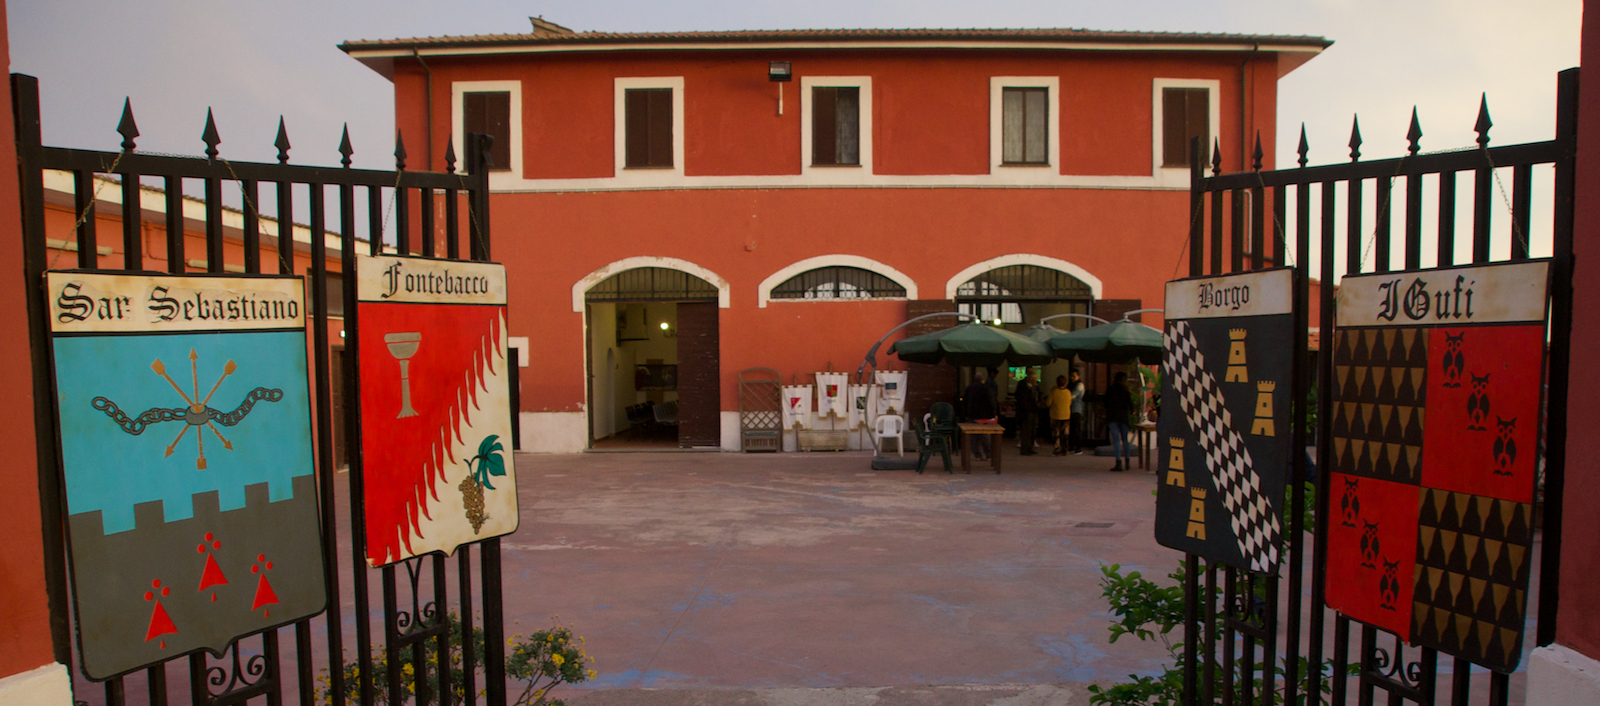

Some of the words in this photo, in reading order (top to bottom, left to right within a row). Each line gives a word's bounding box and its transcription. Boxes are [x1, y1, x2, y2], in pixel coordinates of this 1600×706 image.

[380, 260, 489, 299] Fontebacco
[1198, 282, 1250, 314] Borgo
[148, 285, 298, 324] Sebastiano
